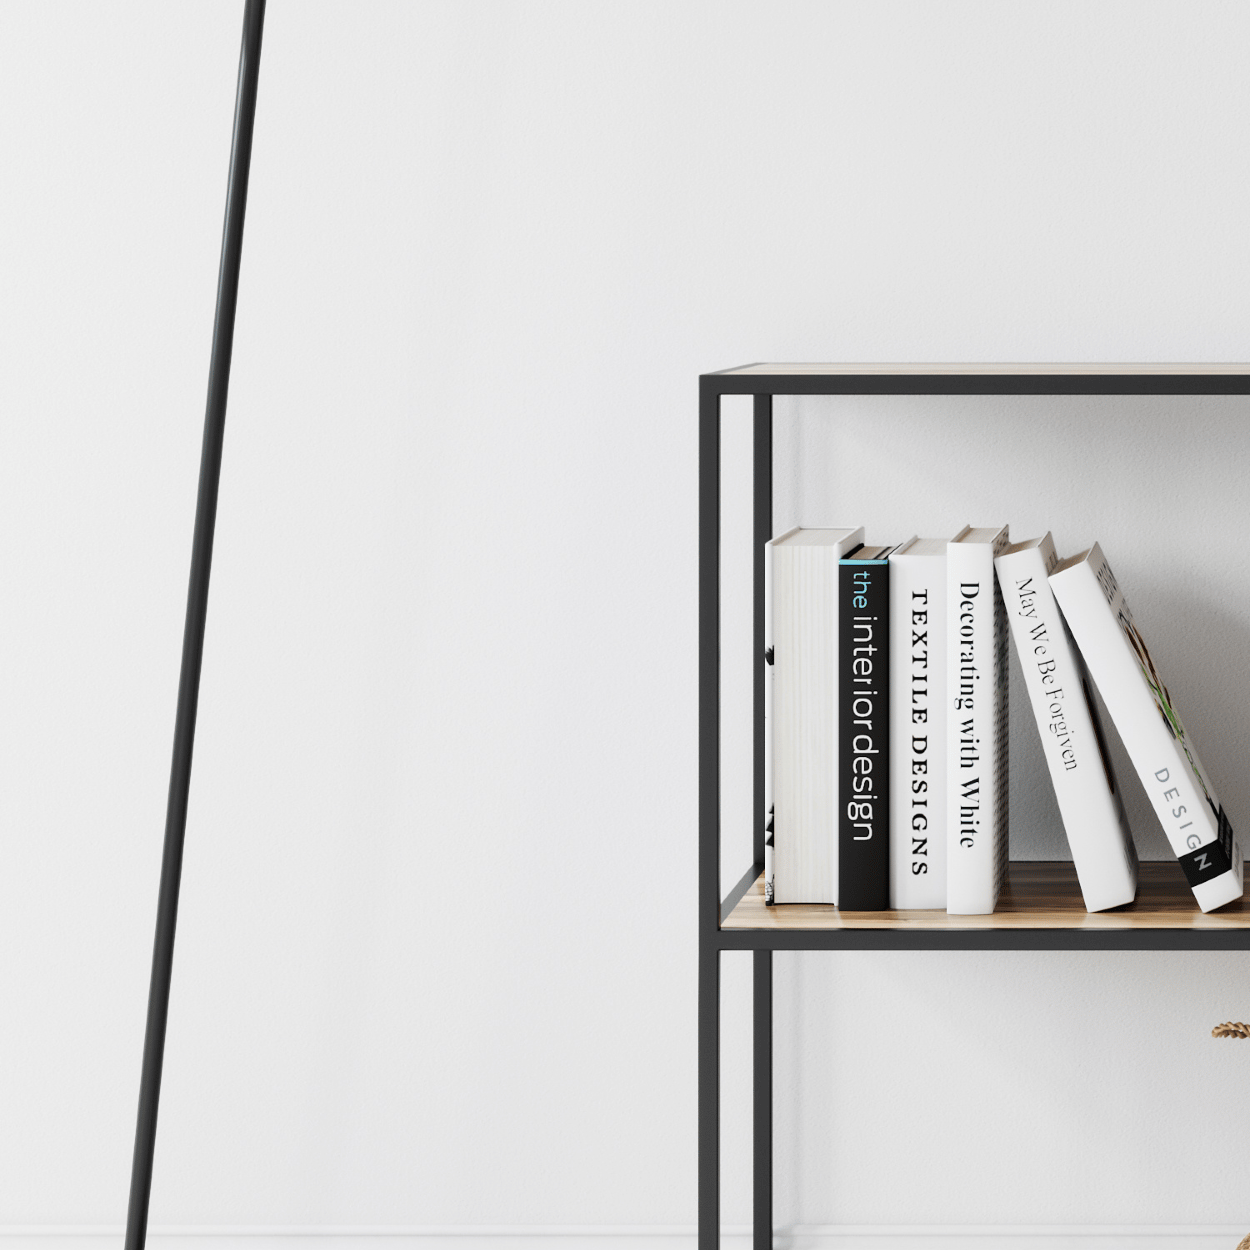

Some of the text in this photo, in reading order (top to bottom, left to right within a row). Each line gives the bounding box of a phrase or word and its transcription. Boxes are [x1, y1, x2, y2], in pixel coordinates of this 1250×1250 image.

[852, 570, 872, 609] the
[1015, 577, 1078, 771] May We Be Forgiven
[911, 588, 928, 876] TEXTILE DESIGNS
[954, 582, 980, 848] Decorating with White
[1154, 767, 1213, 871] DESIGN
